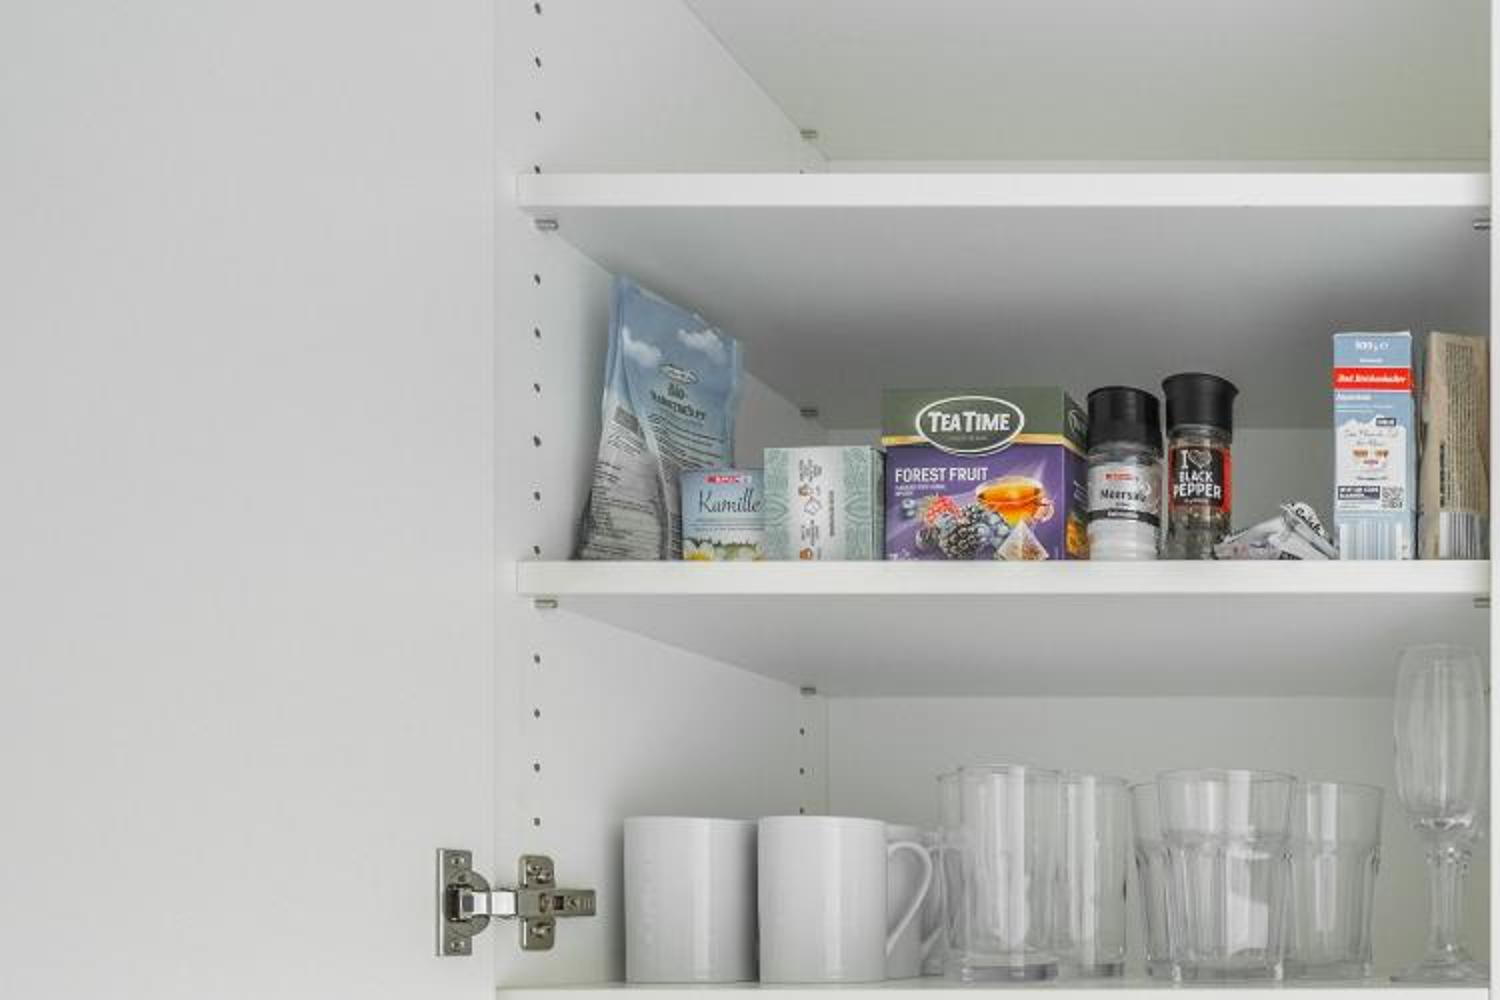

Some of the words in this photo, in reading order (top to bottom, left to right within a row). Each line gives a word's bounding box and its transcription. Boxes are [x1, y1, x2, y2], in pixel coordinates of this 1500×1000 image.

[928, 411, 961, 433] TEA
[962, 411, 1011, 432] TIME
[1180, 449, 1189, 469] I
[895, 468, 945, 483] FOREST
[949, 467, 988, 481] FRUIT
[1179, 471, 1214, 483] BLACK
[699, 487, 761, 513] Kamille
[1173, 483, 1222, 499] PEPPER
